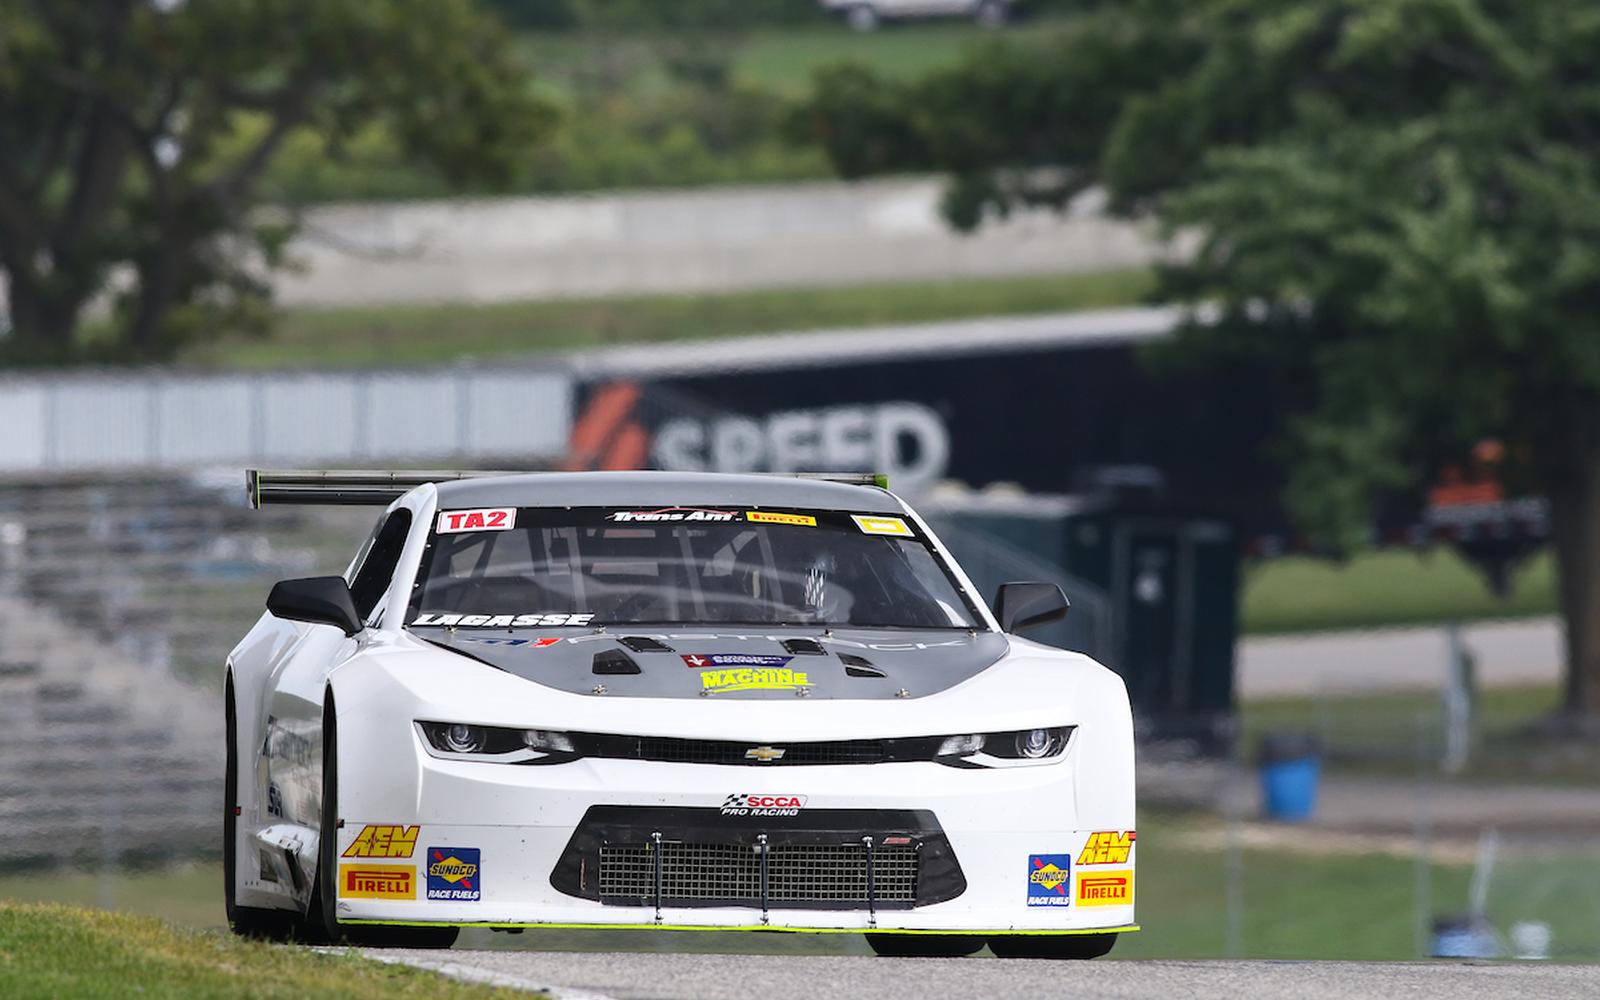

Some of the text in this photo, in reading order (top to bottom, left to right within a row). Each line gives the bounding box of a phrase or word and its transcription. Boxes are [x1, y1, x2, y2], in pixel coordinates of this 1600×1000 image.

[654, 402, 950, 488] SPEED
[447, 511, 508, 529] TA2
[611, 511, 732, 521] Trans Am
[411, 614, 595, 626] LAGASSE
[701, 671, 808, 687] MACHINE
[747, 797, 801, 807] SCCA
[721, 808, 799, 816] PRO RACING
[341, 825, 421, 858] AEM
[1075, 831, 1133, 865] AEM
[431, 864, 476, 875] SUNOCO
[1032, 871, 1068, 882] SUNOCO
[347, 871, 410, 893] PIRELLI
[1080, 878, 1127, 899] PIRELLI
[428, 890, 480, 900] RACE FUELS
